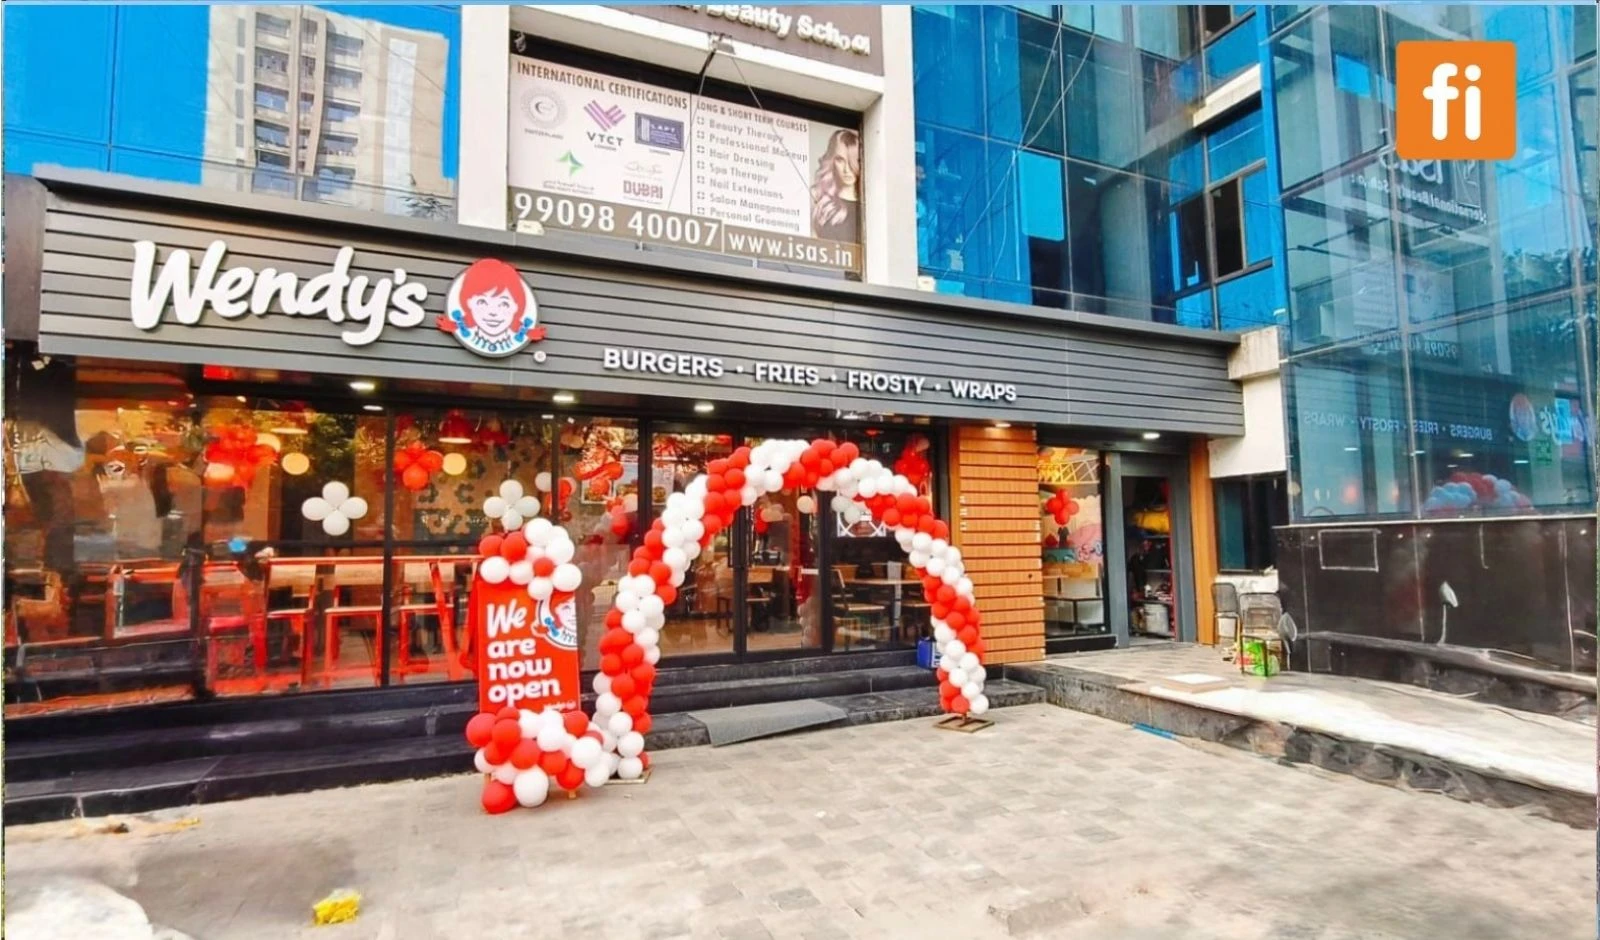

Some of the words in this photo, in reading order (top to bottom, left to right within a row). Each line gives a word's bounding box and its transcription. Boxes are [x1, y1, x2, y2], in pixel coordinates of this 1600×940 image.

[517, 61, 605, 92] INTERNATIONAL
[608, 82, 688, 110] CERTIFICATIONS
[697, 100, 718, 113] LONG
[720, 107, 726, 115] &
[728, 107, 752, 121] SHORT
[754, 114, 774, 125] TERM
[776, 119, 808, 133] COURSES
[587, 131, 624, 146] VTCT
[709, 119, 743, 135] Beauty
[747, 126, 784, 142] Therapy
[709, 133, 770, 153] Professional
[772, 148, 808, 163] Makeup
[709, 148, 730, 161] Hair
[733, 153, 775, 171] Dressing
[709, 162, 728, 175] Spa
[731, 167, 769, 184] Therapy
[709, 178, 730, 189] Nail
[732, 182, 784, 200] Extensions
[709, 193, 737, 206] Salon
[740, 199, 800, 217] Management
[514, 192, 615, 232] 99098
[627, 211, 720, 247] 40007
[709, 207, 752, 222] Personal
[754, 214, 800, 232] Grooming
[729, 233, 853, 267] www.isas.in
[130, 239, 428, 347] Wendy's
[603, 348, 724, 379] BURGERS
[754, 362, 820, 387] FRIES
[847, 370, 926, 396] FROSTY
[951, 379, 1017, 402] WRAPS
[486, 598, 528, 638] We
[487, 638, 536, 659] are
[487, 657, 552, 681] now
[488, 678, 562, 708] open
